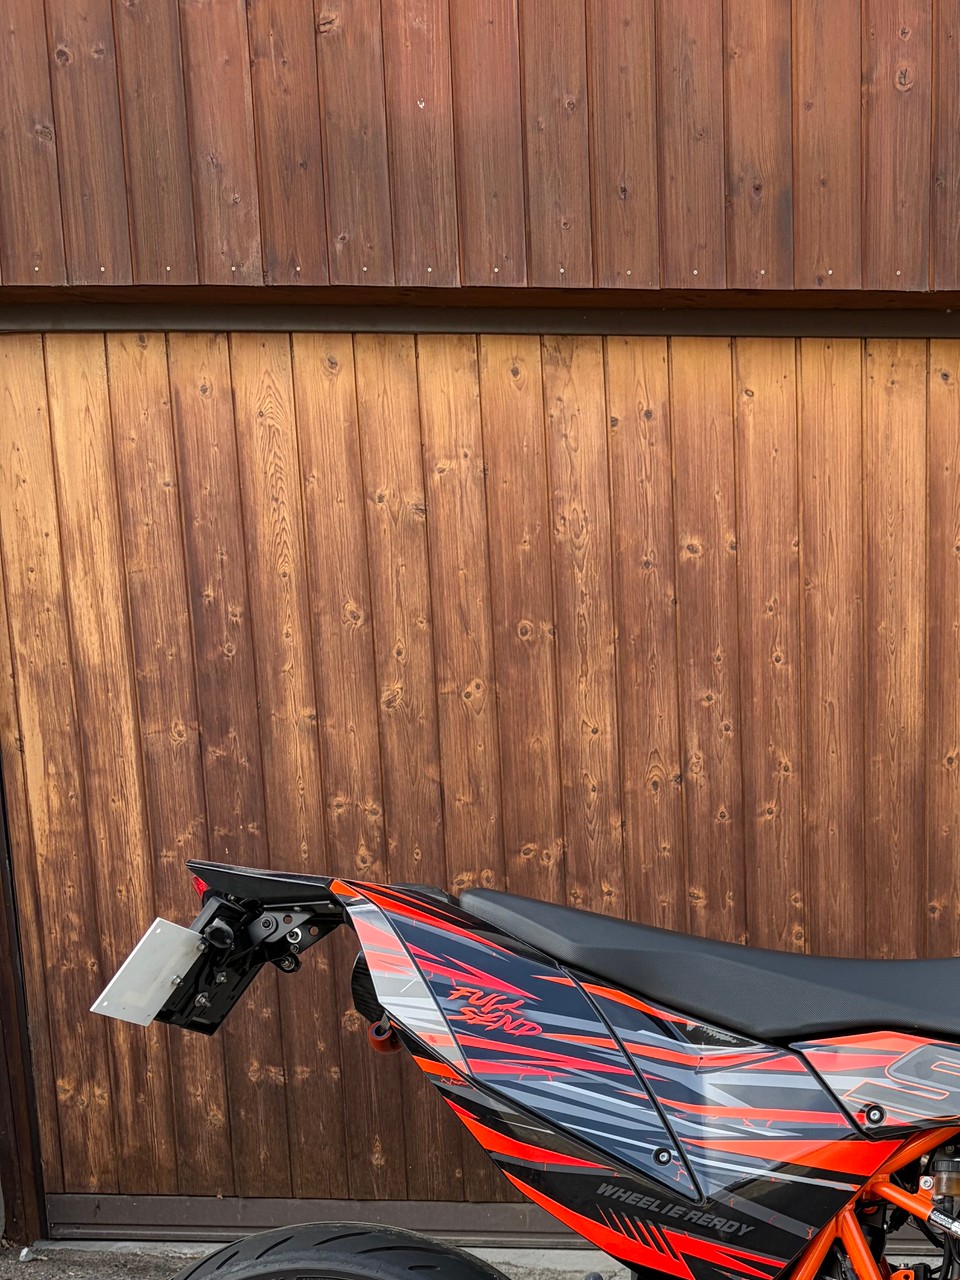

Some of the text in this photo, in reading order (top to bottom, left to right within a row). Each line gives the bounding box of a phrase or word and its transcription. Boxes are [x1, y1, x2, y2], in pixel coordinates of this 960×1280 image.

[447, 986, 525, 1014] FULL
[447, 1006, 543, 1037] SEND
[596, 1183, 755, 1236] WHEELIE READY
